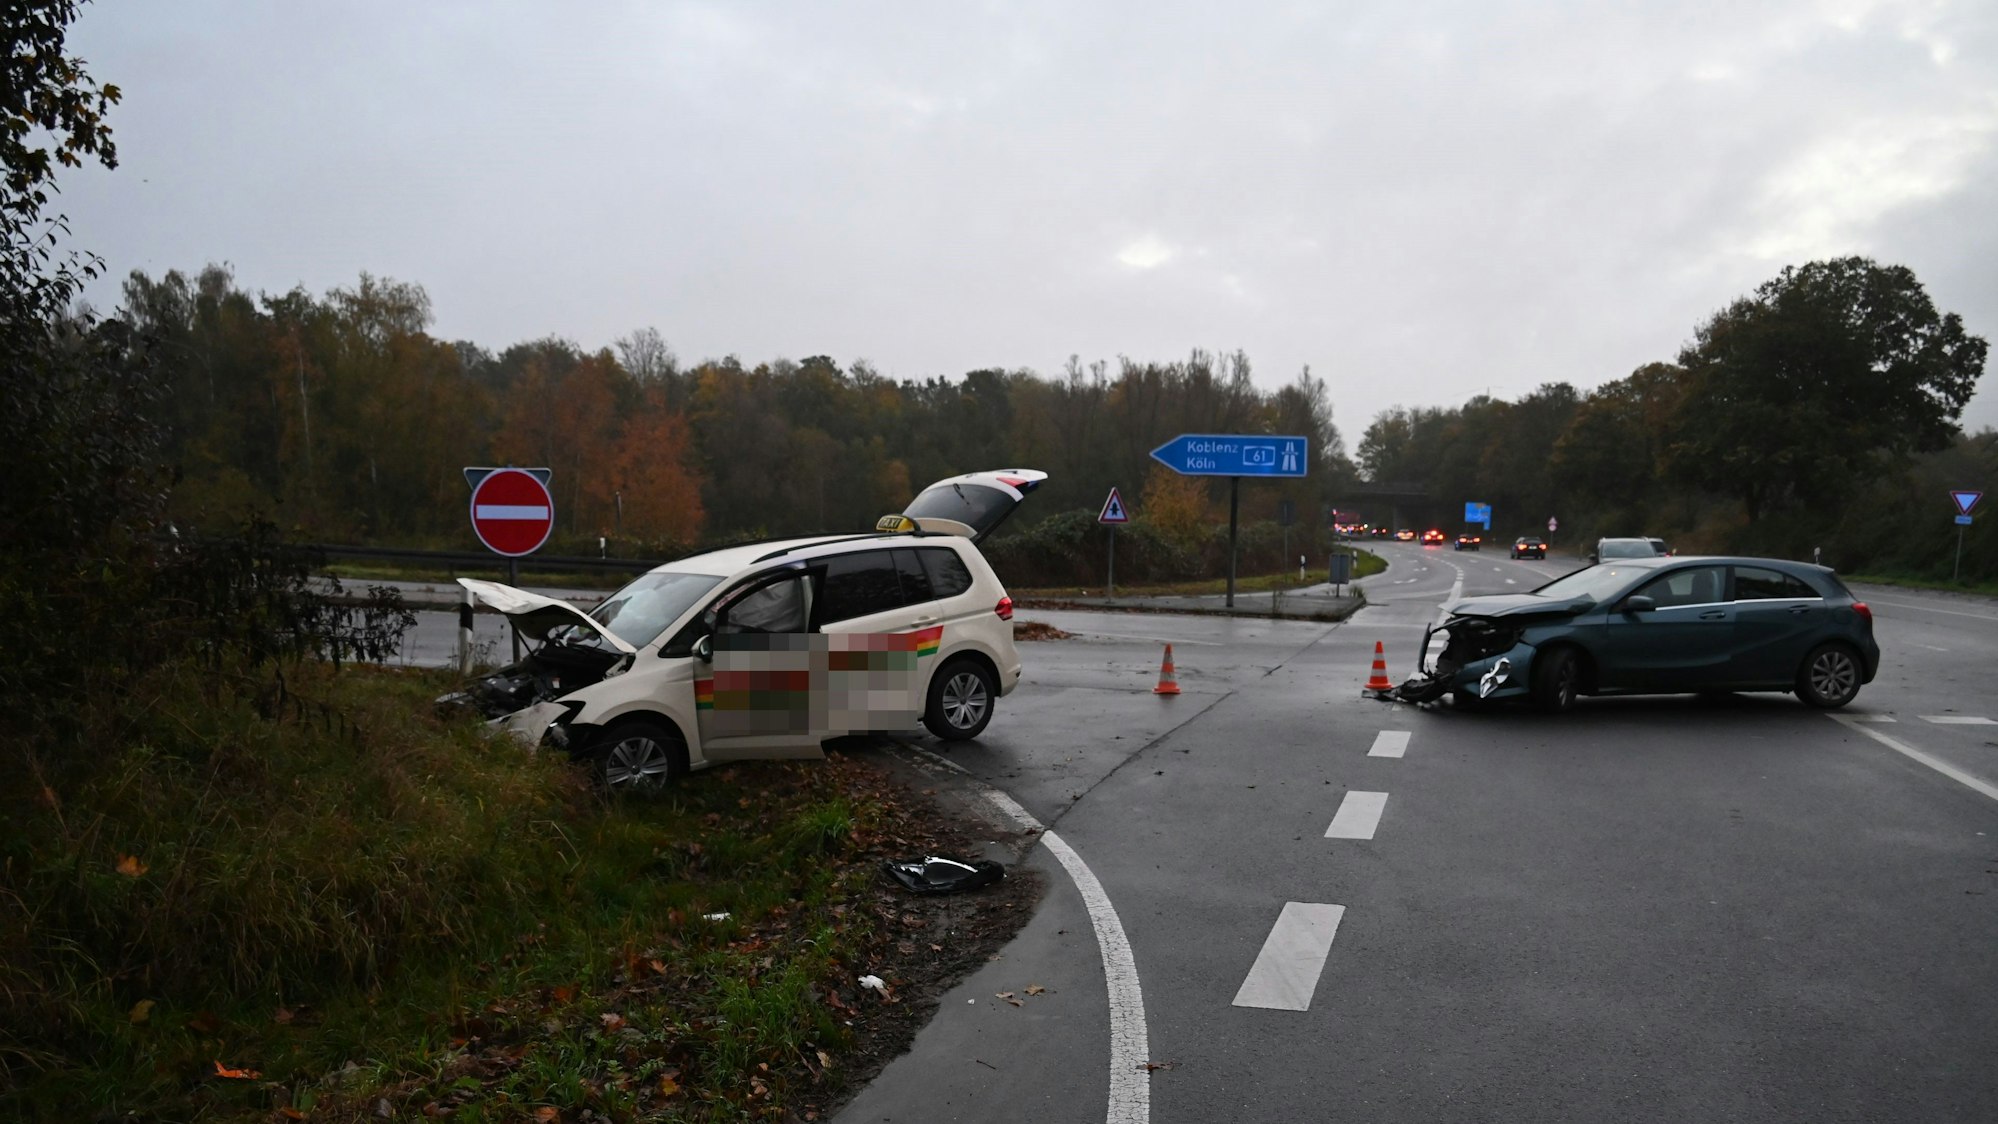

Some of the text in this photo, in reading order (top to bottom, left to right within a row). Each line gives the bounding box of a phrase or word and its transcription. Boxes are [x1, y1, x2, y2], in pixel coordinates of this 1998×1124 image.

[1187, 441, 1239, 453] Koblenz
[1253, 450, 1266, 462] 61
[1186, 457, 1216, 469] Köln
[879, 518, 901, 528] TAXI
